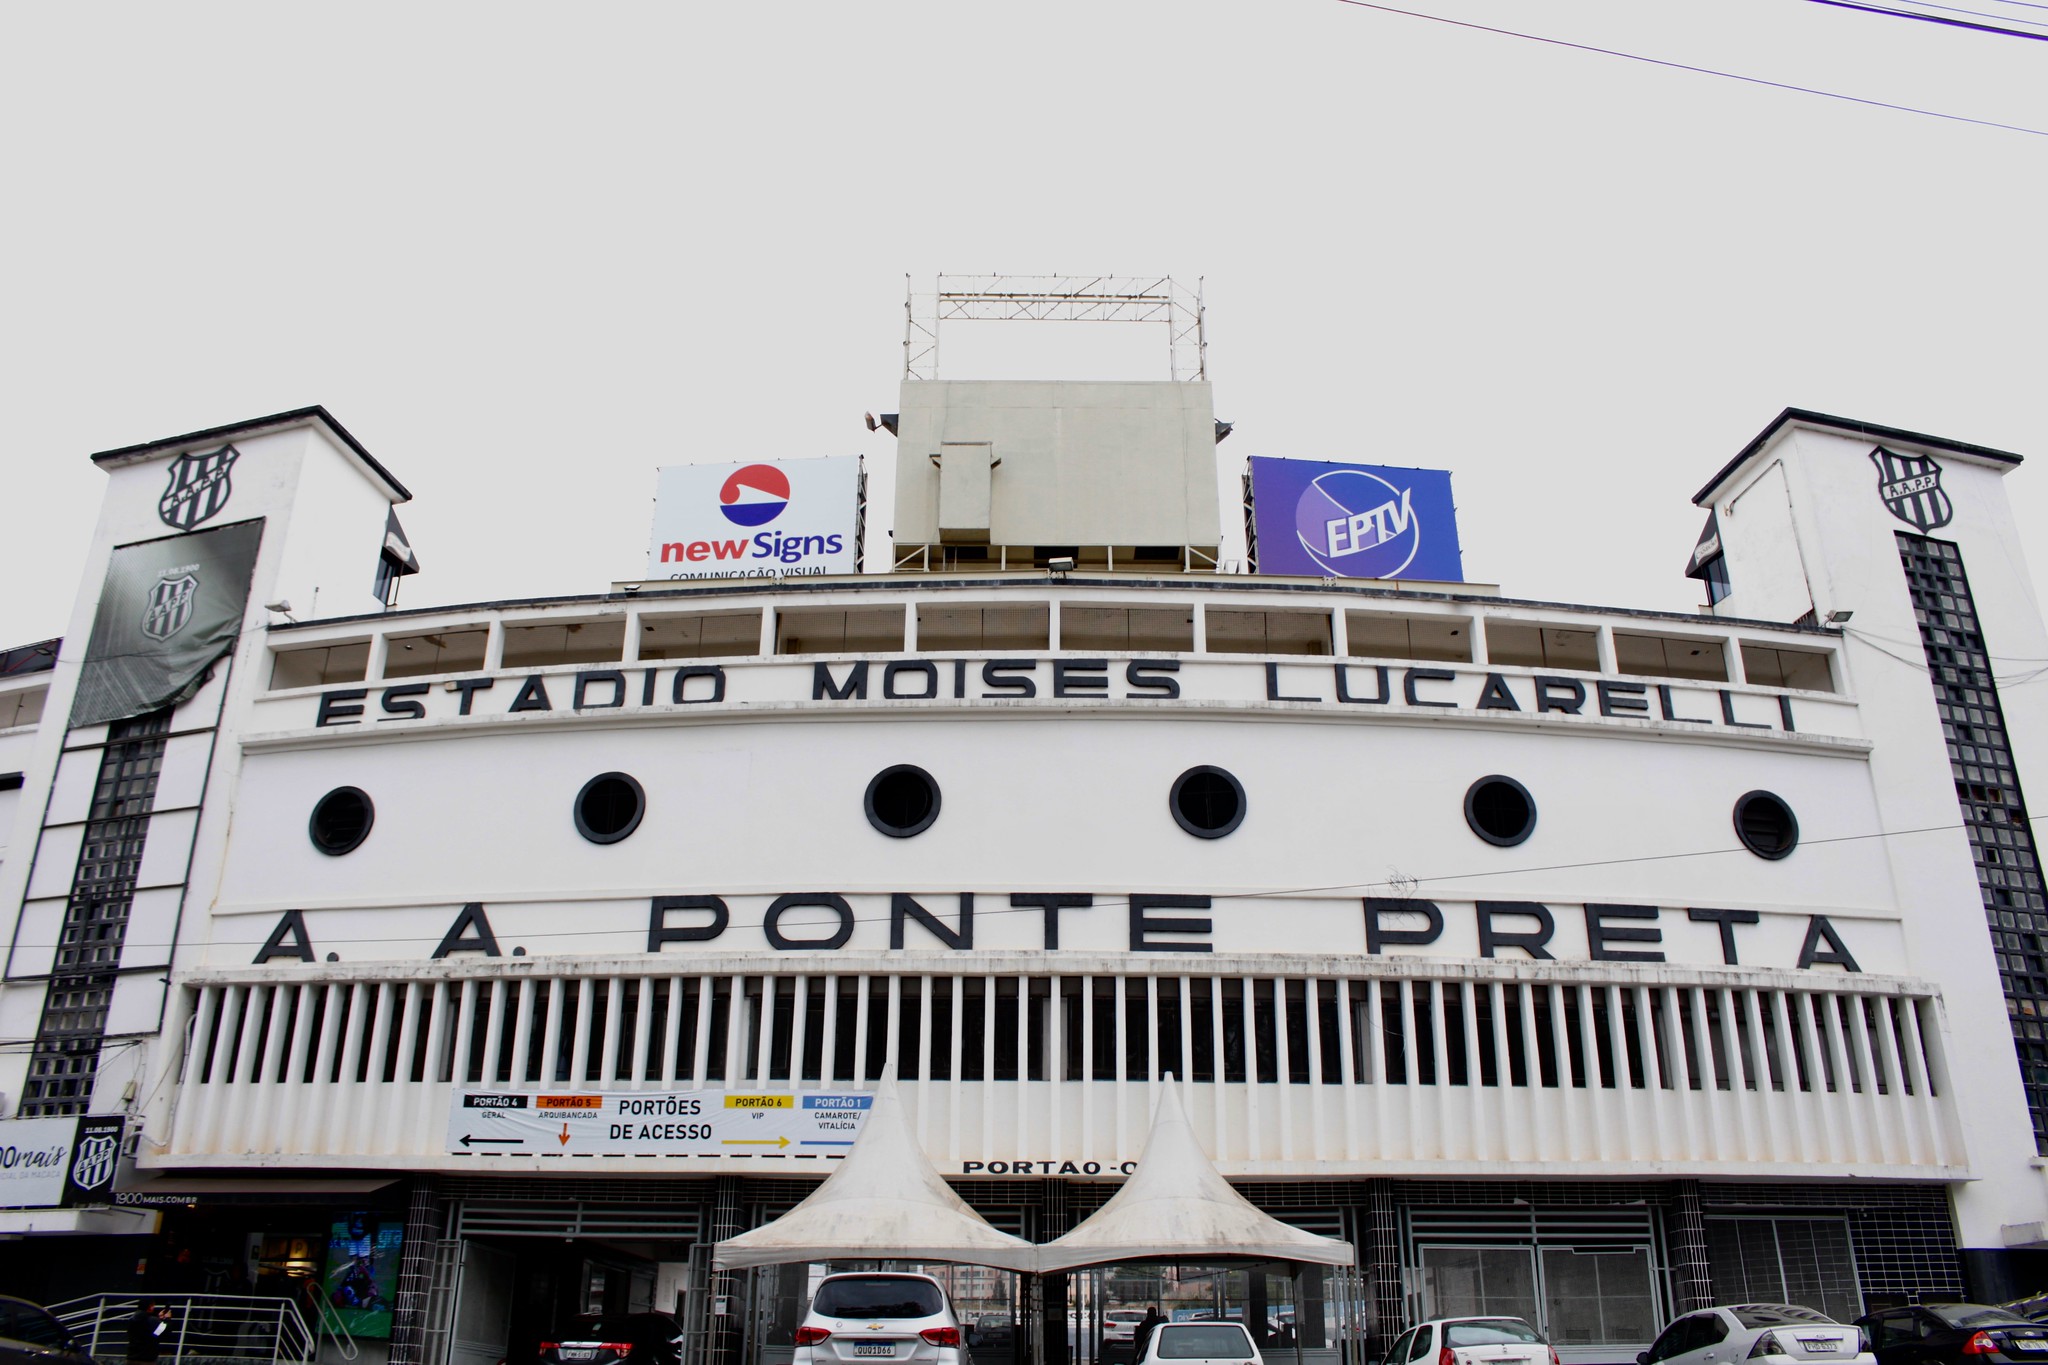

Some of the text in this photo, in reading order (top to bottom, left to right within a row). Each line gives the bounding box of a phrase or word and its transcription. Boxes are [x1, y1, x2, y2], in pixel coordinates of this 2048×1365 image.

[1889, 477, 1935, 498] A.A.P.P.
[1327, 487, 1411, 558] EPTV
[315, 658, 1796, 731] ESTADIO MOISES LUCARELLI
[252, 892, 1863, 972] A. A. PONTE PRETA
[473, 1095, 519, 1107] PORTÃO 4
[546, 1096, 592, 1107] PORTÃO 5
[619, 1095, 701, 1115] PORTÕES
[735, 1096, 783, 1107] PORTÃO 6
[815, 1096, 854, 1107] PORTÃO
[814, 1112, 861, 1120] CAMAROTE/
[609, 1124, 712, 1140] DE ACESSO
[818, 1122, 856, 1130] VITALÍCIA
[858, 1346, 891, 1355] QUQ1D66
